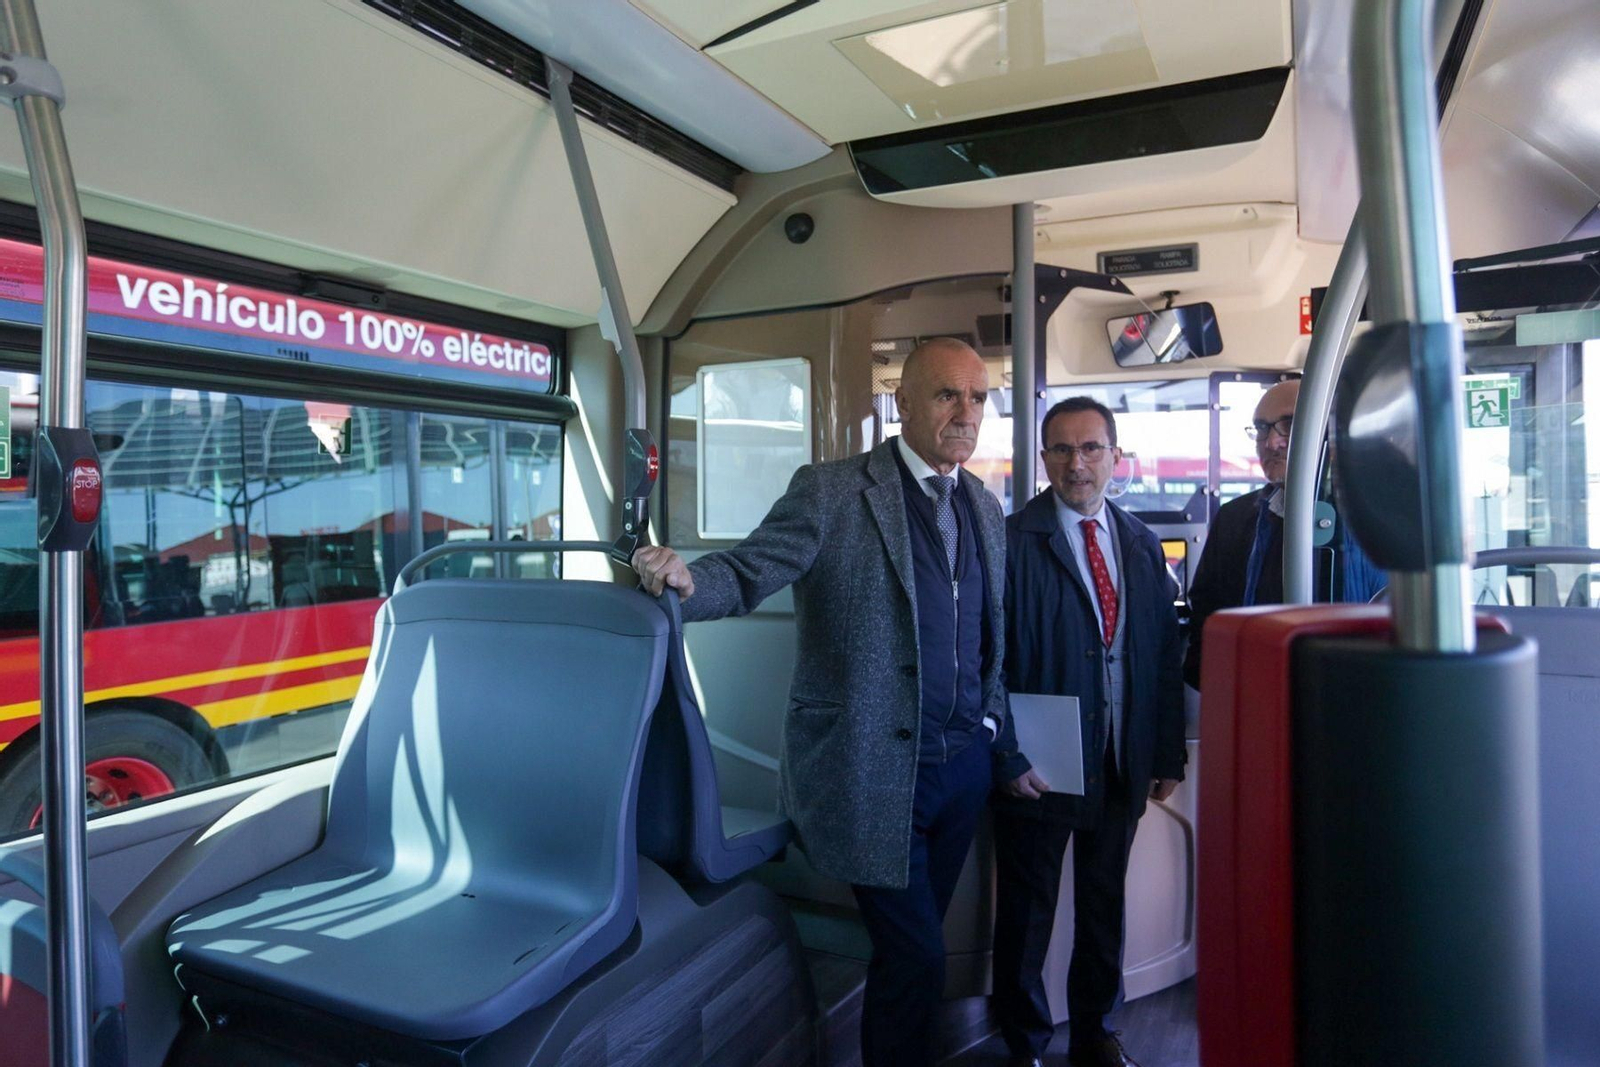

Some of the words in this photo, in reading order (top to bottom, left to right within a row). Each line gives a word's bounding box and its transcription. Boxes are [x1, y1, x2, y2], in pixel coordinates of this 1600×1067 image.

[116, 273, 326, 340] vehículo
[338, 311, 435, 358] 100%
[75, 480, 98, 489] STOP
